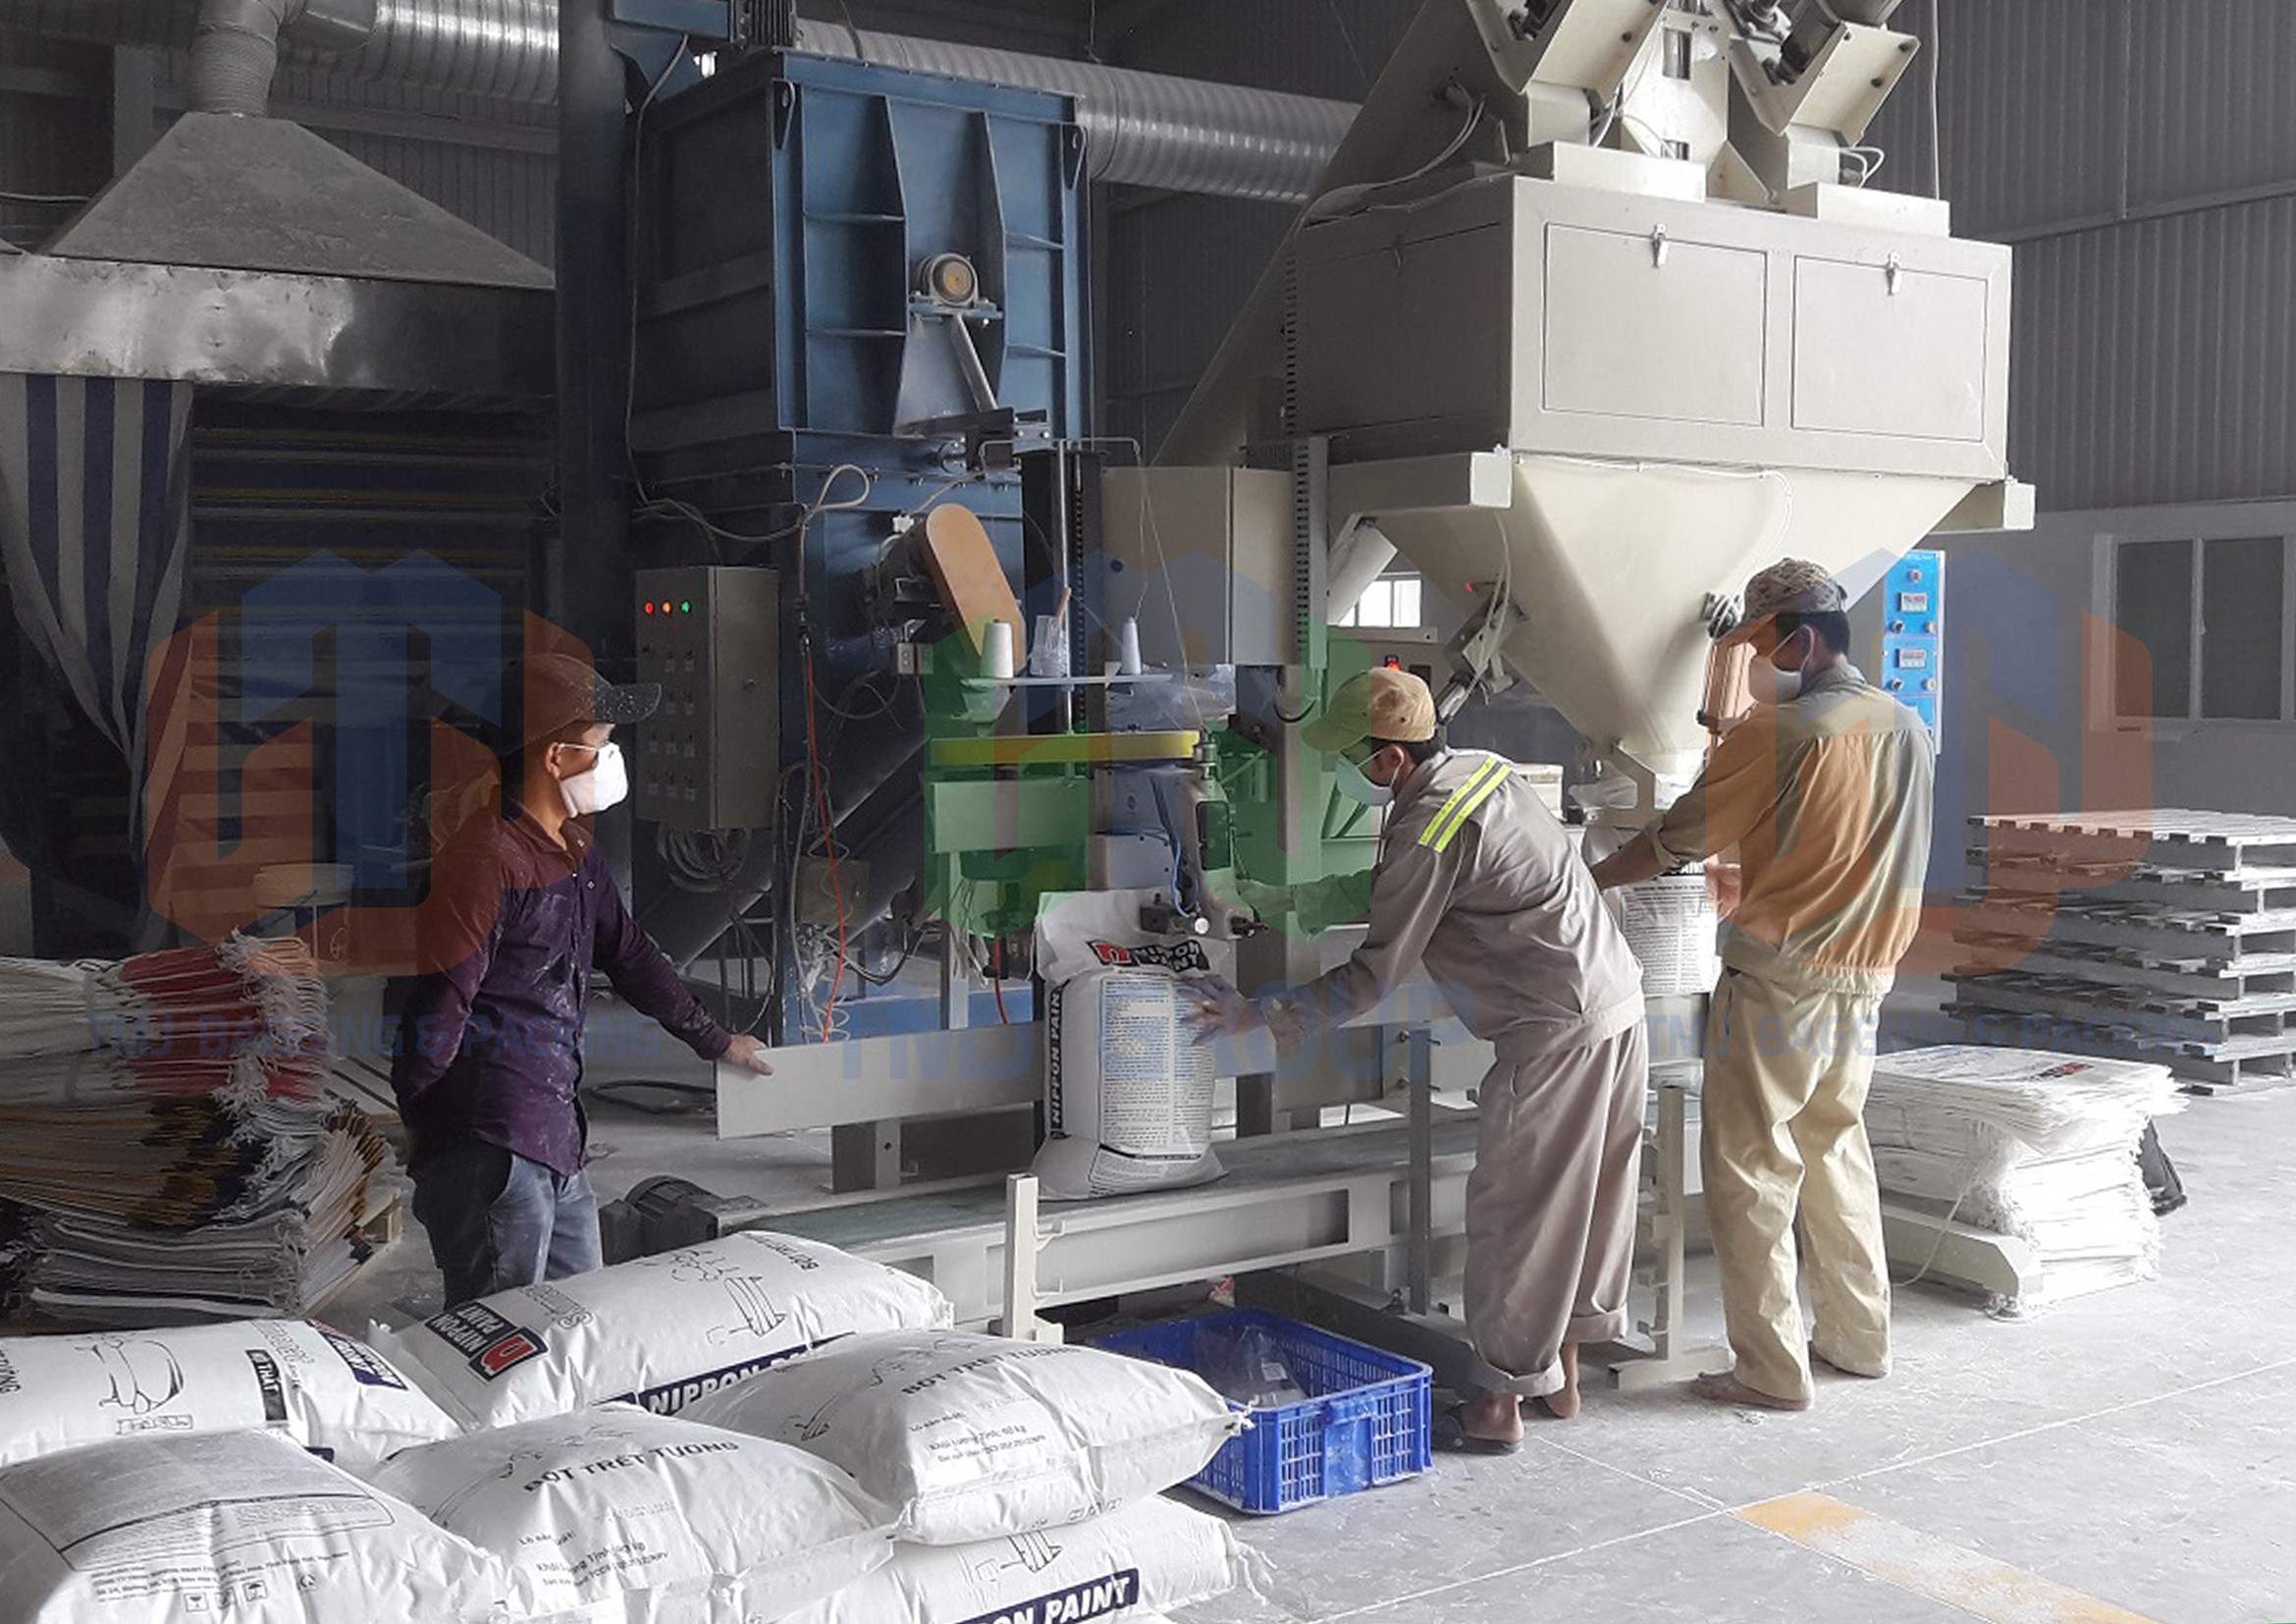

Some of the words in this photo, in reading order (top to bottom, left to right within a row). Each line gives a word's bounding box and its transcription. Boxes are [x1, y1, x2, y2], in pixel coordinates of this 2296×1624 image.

[1050, 987, 1062, 1040] PAIN
[432, 1313, 488, 1352] NIPPON
[457, 1305, 504, 1334] PAINT
[1044, 1576, 1131, 1624] PAINT
